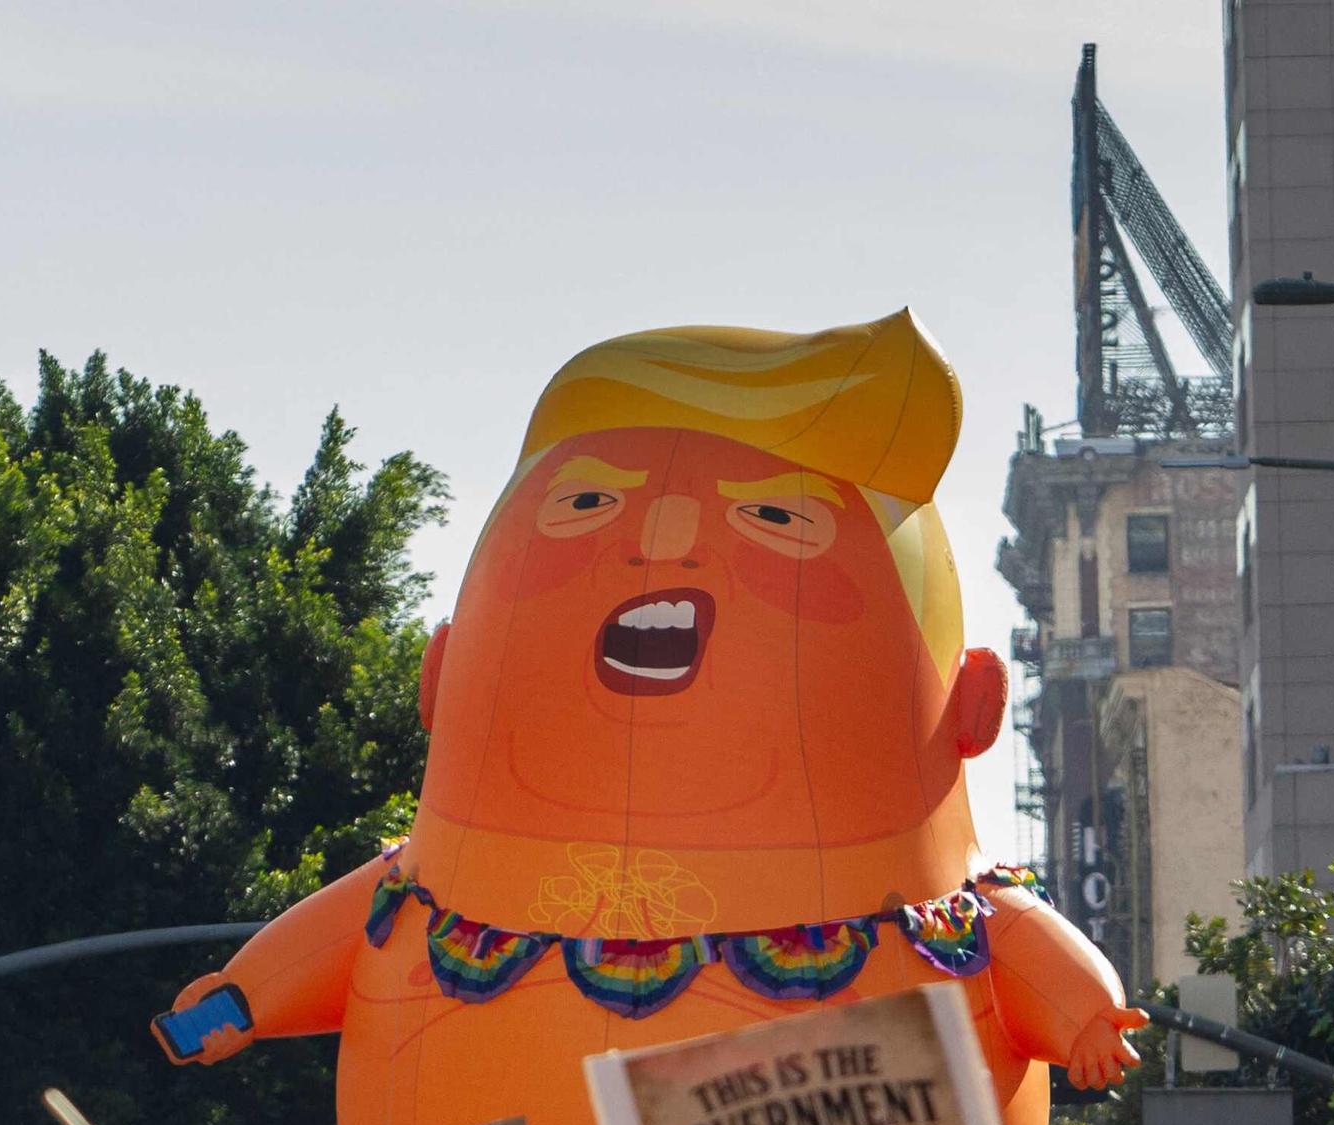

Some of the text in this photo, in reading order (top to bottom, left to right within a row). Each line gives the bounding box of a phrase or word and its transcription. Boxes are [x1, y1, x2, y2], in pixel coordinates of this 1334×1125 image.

[691, 1042, 882, 1116] THIS IS THE
